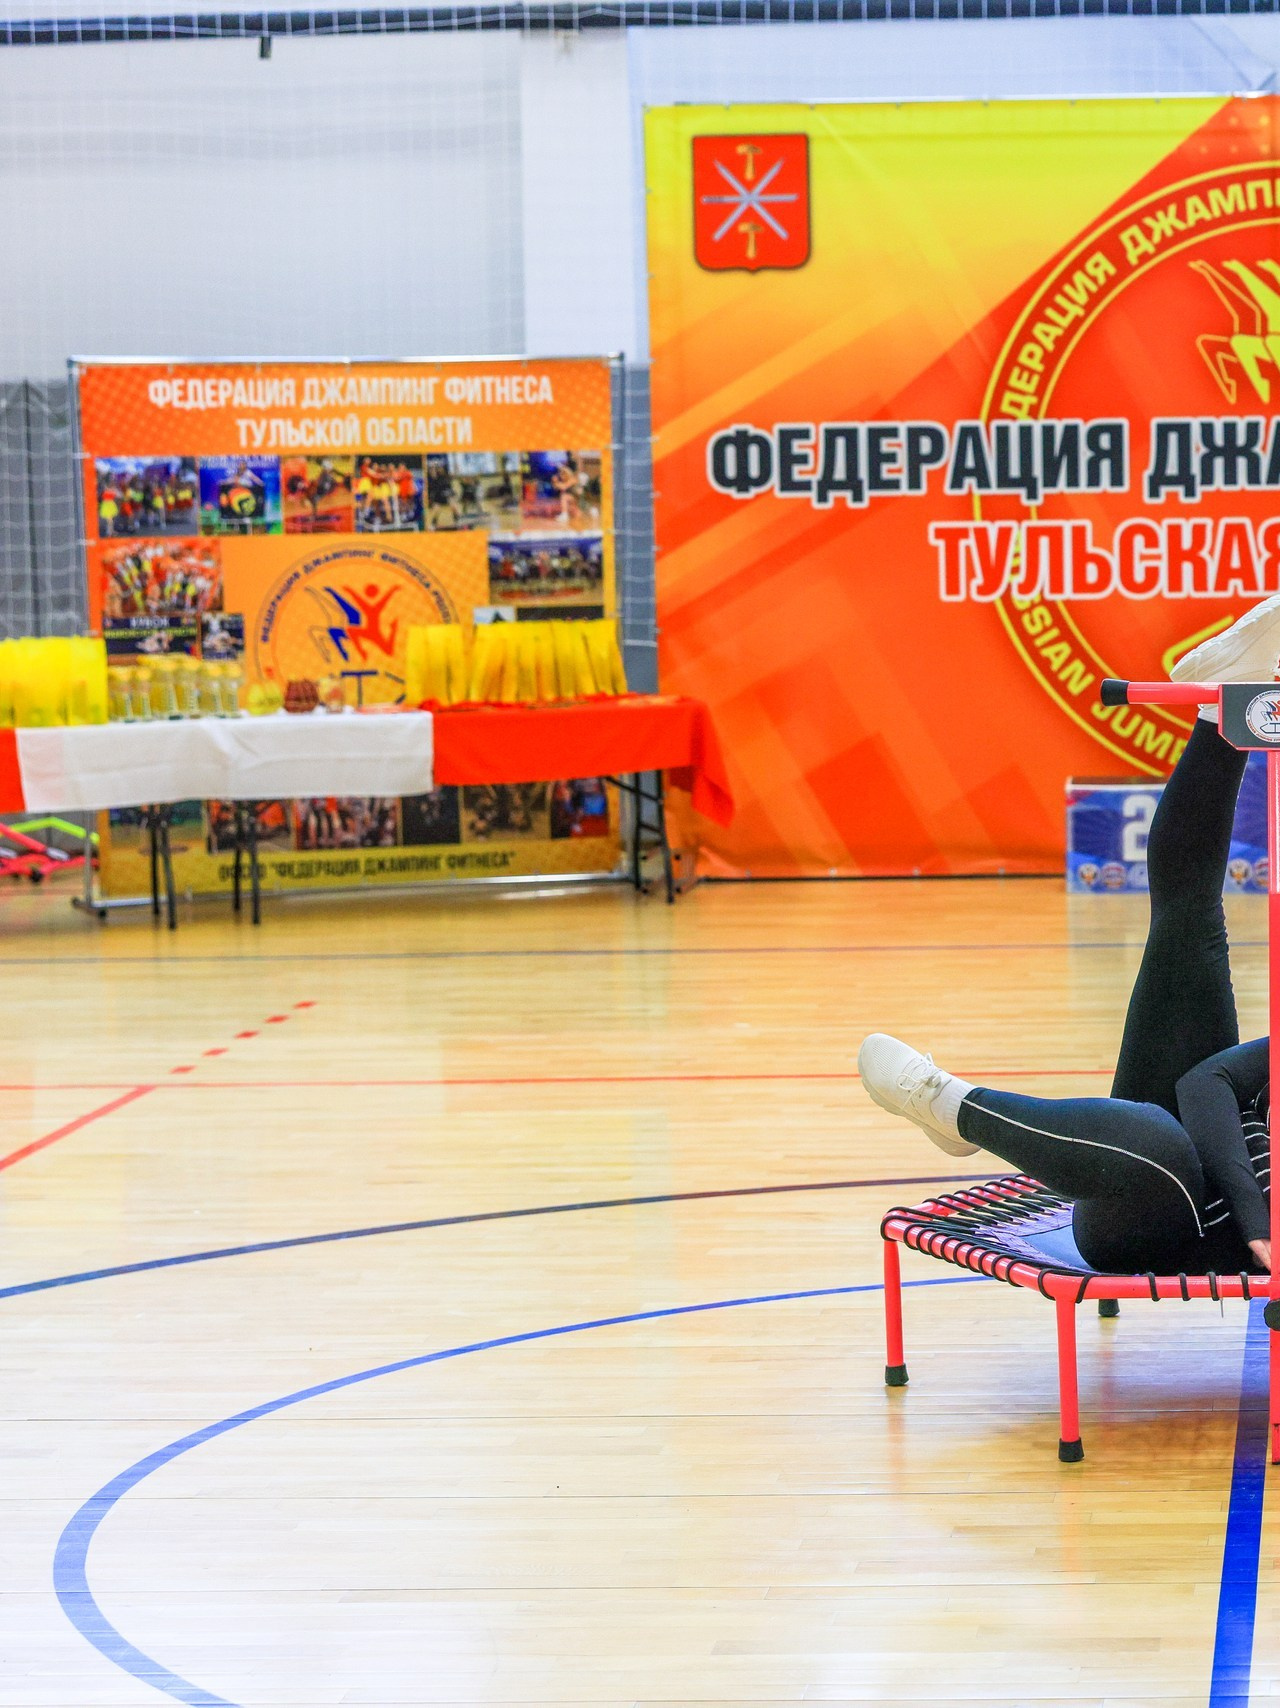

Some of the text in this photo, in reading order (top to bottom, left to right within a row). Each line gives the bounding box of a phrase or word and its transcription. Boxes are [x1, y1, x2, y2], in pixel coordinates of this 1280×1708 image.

[1000, 251, 1117, 420] ДЕРАЦИЯ
[148, 376, 553, 409] ФЕДЕРАЦИЯ ДЖАМПИНГ ФИТНЕСА
[236, 414, 472, 448] ТУЛЬСКОЙ ОБЛАСТИ
[708, 418, 1129, 507] ФЕДЕРАЦИЯ
[1011, 592, 1095, 696] SIAN
[1122, 794, 1157, 862] 2
